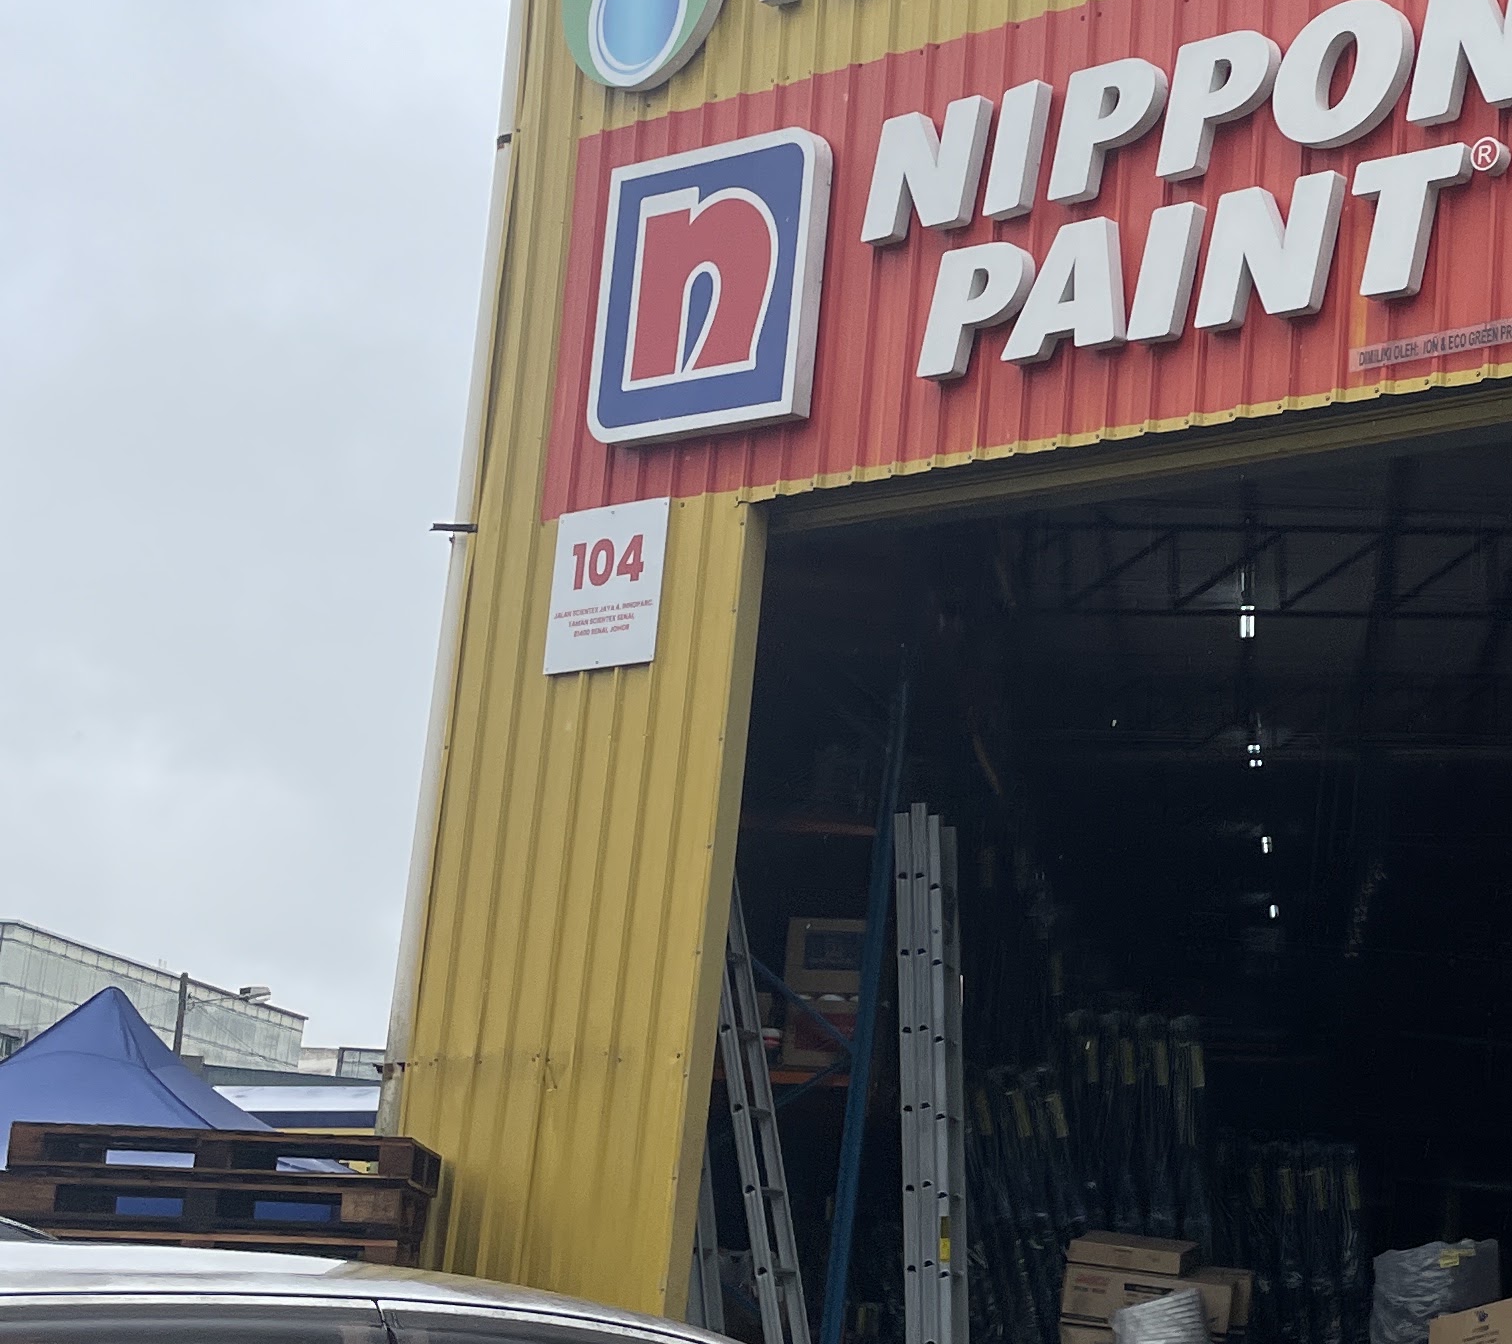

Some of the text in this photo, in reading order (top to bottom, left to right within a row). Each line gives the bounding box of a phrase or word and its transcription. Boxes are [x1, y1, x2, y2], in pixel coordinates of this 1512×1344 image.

[1422, 337, 1439, 355] ION
[1440, 336, 1447, 351] &
[1448, 333, 1466, 350] ECO
[1468, 327, 1498, 346] GREEN
[572, 534, 644, 590] 104
